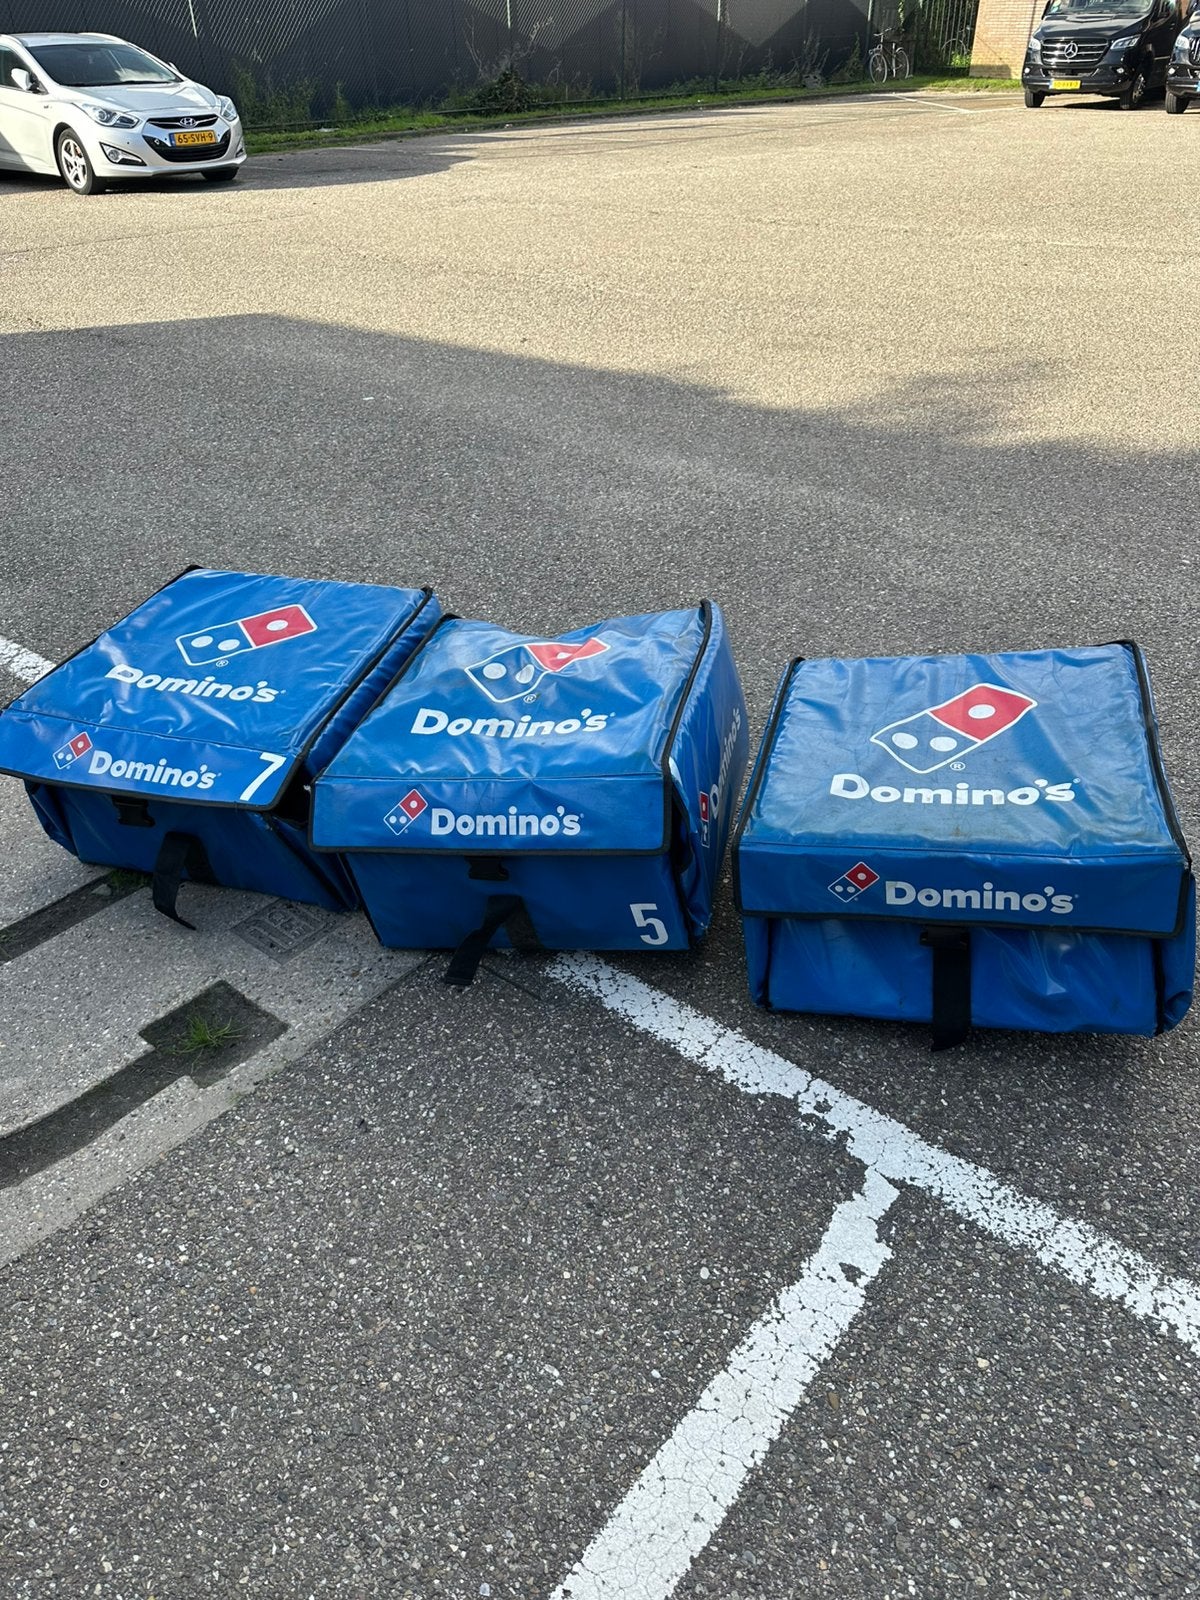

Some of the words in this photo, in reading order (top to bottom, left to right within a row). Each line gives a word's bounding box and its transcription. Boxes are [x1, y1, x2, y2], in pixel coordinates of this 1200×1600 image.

[177, 132, 213, 144] 65-SVH-9
[104, 663, 280, 703] Domino's
[410, 707, 609, 738] Domino's
[88, 750, 218, 789] Domino's
[239, 752, 287, 801] 7
[829, 773, 1076, 806] Domino's
[430, 805, 581, 836] Domino's
[884, 880, 1074, 915] Domino's
[629, 902, 669, 946] 5
